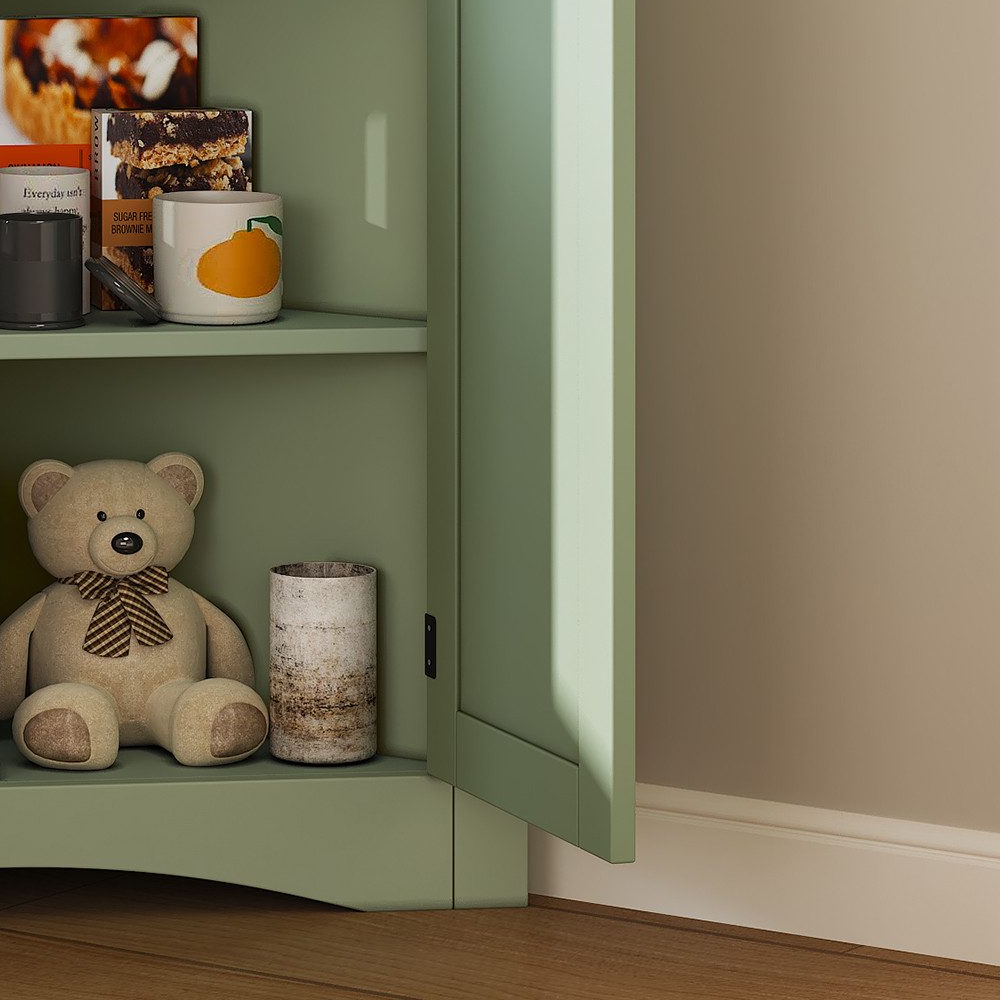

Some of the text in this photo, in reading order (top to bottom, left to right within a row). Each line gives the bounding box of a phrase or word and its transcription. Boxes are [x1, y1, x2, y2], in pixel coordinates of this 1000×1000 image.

[23, 186, 82, 200] Everyday isn't
[113, 211, 153, 222] SUGAR FRE
[111, 224, 144, 234] BROWNIE
